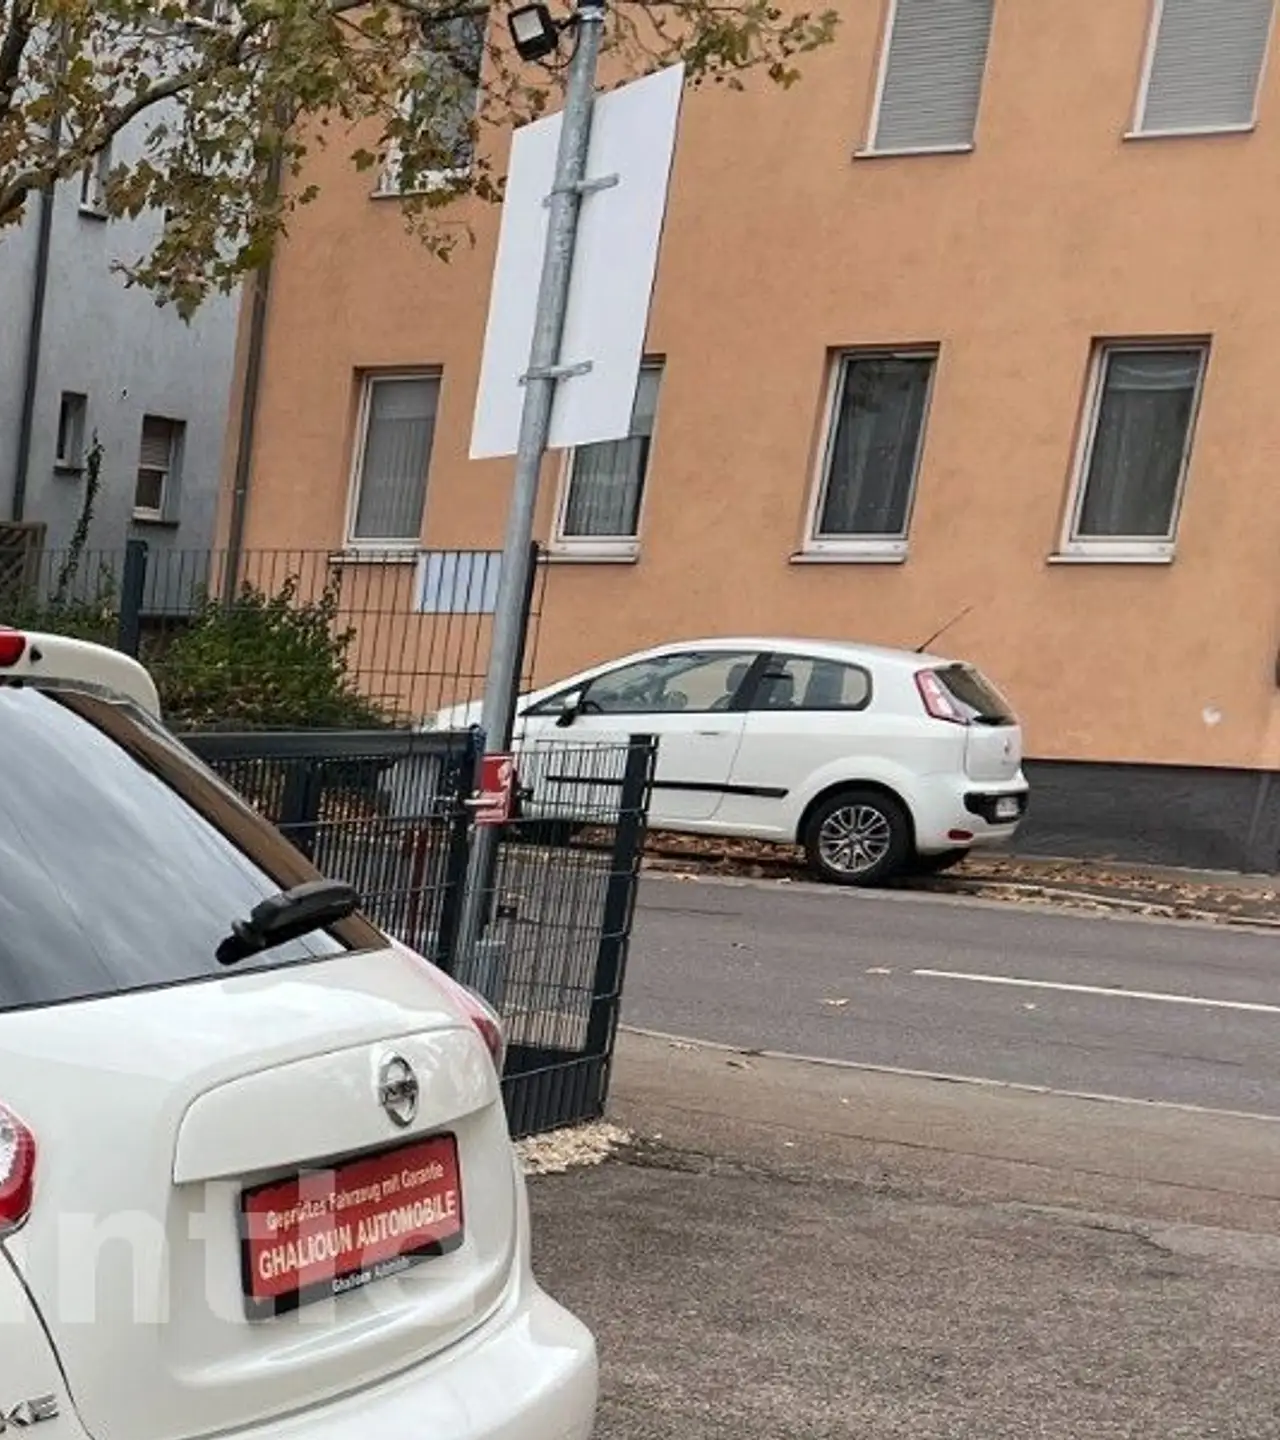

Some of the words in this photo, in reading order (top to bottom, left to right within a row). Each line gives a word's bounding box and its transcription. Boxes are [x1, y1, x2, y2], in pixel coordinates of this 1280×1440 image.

[329, 1182, 381, 1211] Fahrzeug
[382, 1174, 400, 1197] mit
[401, 1162, 444, 1188] Garantie
[259, 1225, 352, 1280] GHALIOUN
[356, 1190, 457, 1248] AUTOMOBILE
